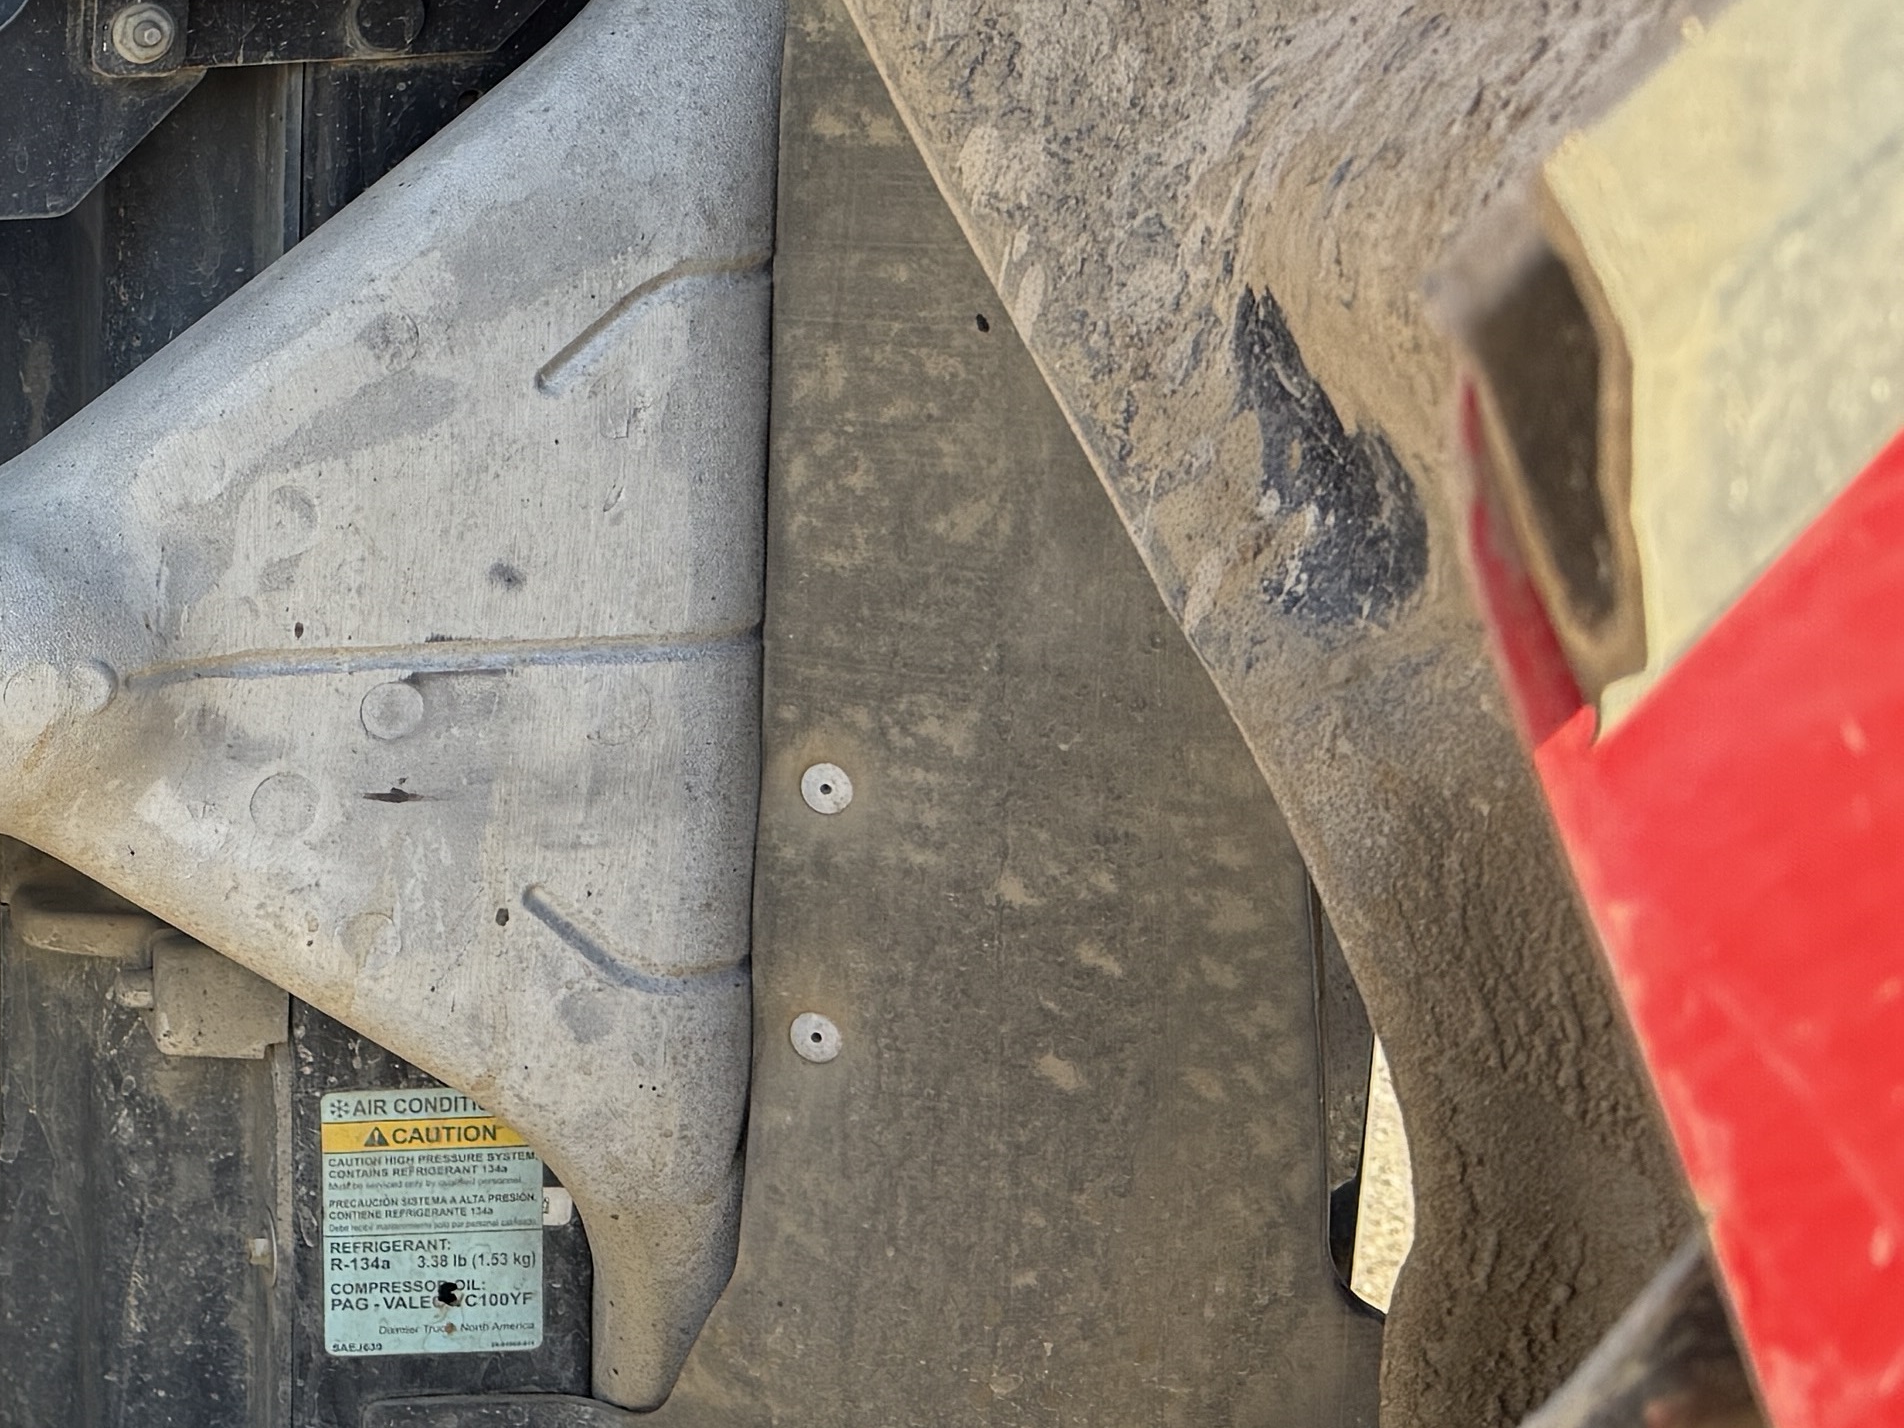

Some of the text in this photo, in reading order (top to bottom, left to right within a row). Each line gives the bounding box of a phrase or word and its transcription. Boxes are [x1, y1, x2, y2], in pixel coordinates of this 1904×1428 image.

[353, 1099, 387, 1116] AIR
[392, 1124, 497, 1144] CAUTION
[329, 1156, 382, 1168] CAUTION
[385, 1154, 414, 1166] HIGH
[418, 1153, 482, 1164] PRESSURE
[329, 1164, 508, 1179] CONTAINS REFRIGERANT 134a
[401, 1194, 447, 1206] SISTEMA
[449, 1196, 458, 1205] A
[459, 1194, 485, 1205] ALTA
[329, 1207, 493, 1220] CONTIENE REFRIGERANTE 134a
[330, 1239, 451, 1254] REFRIGERANT:
[330, 1251, 536, 1271] R-134a 3.38 lb (1.53 kg)
[456, 1279, 486, 1291] OIL:
[331, 1298, 369, 1311] PAG
[423, 1325, 456, 1335] Truc
[460, 1323, 489, 1332] North
[492, 1322, 535, 1332] America
